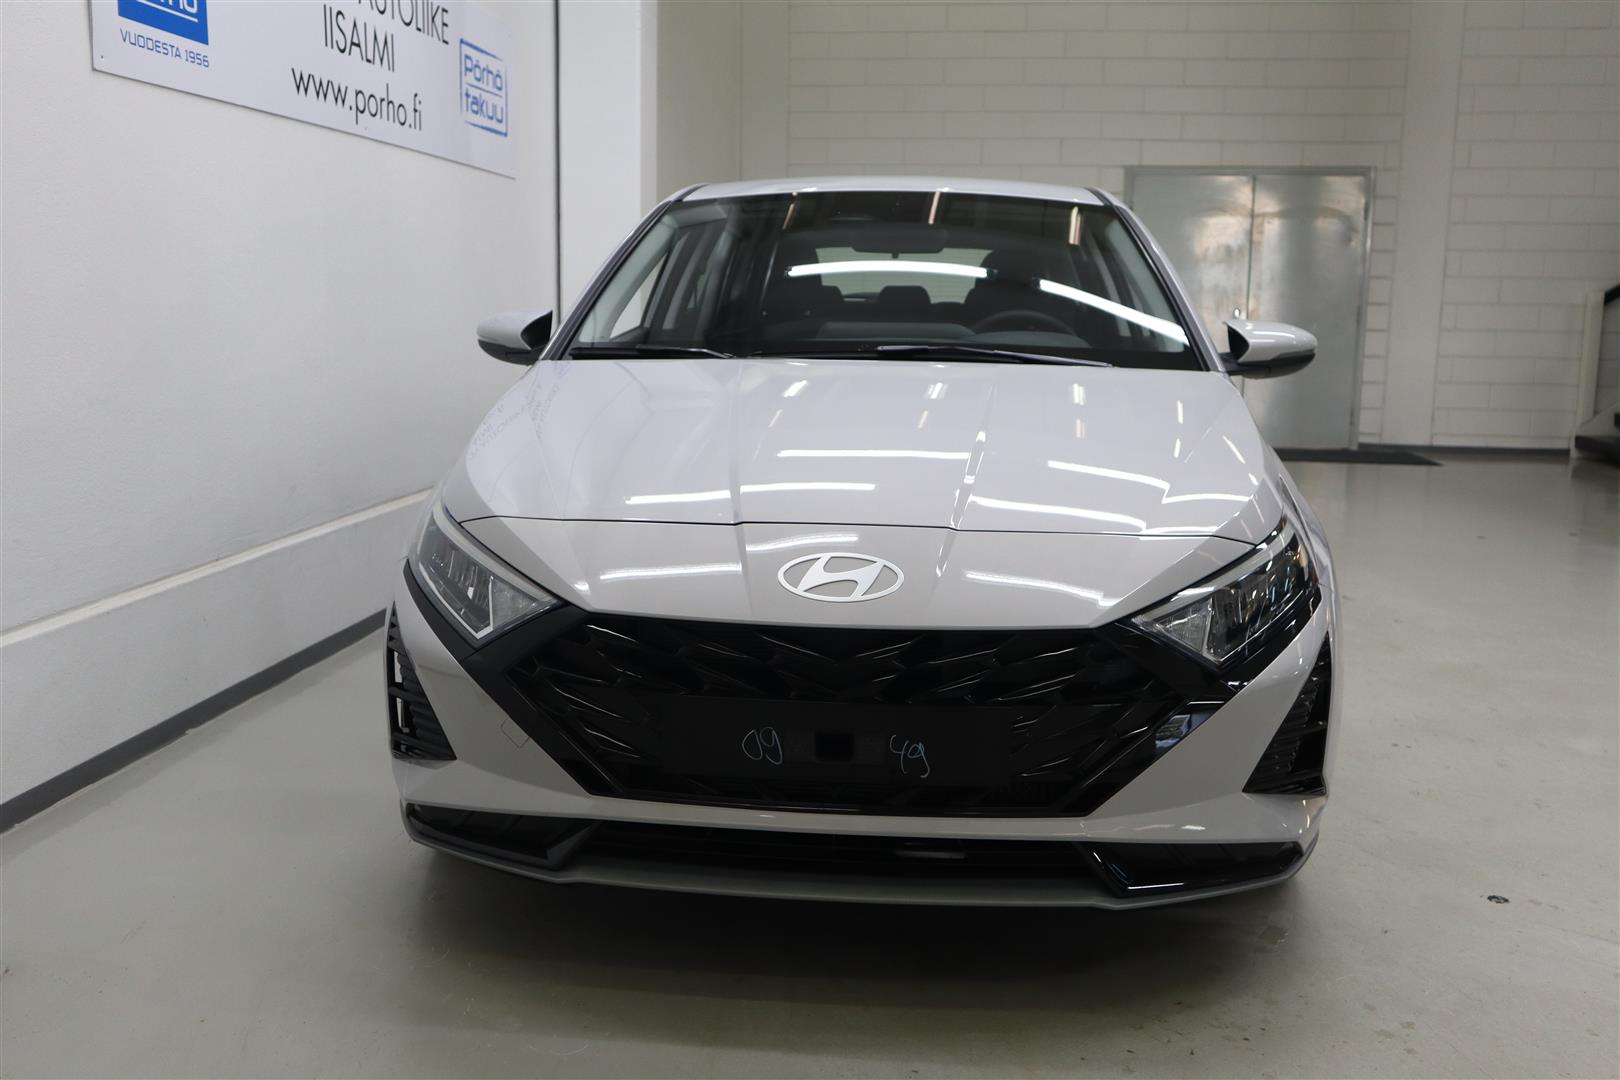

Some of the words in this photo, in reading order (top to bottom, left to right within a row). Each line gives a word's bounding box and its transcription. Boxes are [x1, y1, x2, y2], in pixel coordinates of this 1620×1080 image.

[323, 4, 395, 72] IISALMI
[358, 0, 449, 45] OLIIKE
[120, 28, 182, 59] VUODESTA
[184, 49, 209, 68] 1956
[291, 67, 422, 131] www.porho.fi
[464, 87, 504, 124] takuu
